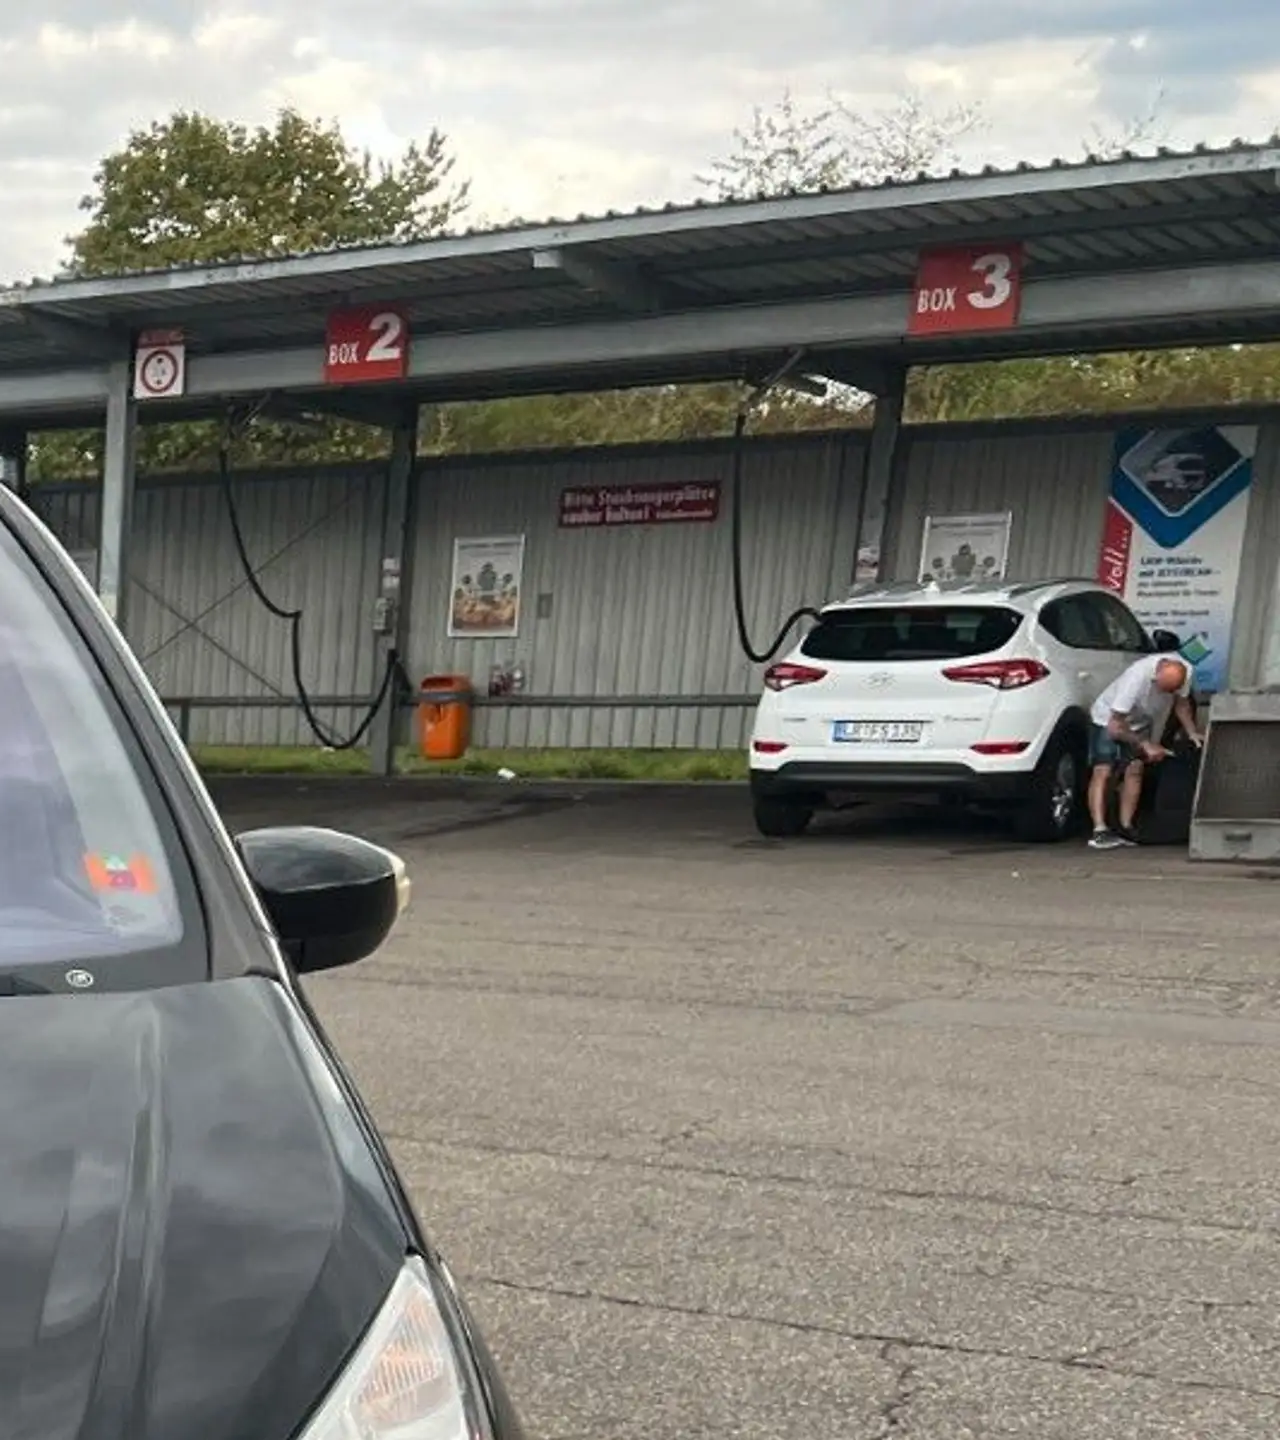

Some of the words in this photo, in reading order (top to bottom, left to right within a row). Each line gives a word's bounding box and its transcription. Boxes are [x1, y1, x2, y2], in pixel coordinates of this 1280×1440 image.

[916, 286, 957, 313] BOX
[967, 253, 1011, 309] 3
[328, 341, 360, 366] BOX
[365, 312, 401, 362] 2
